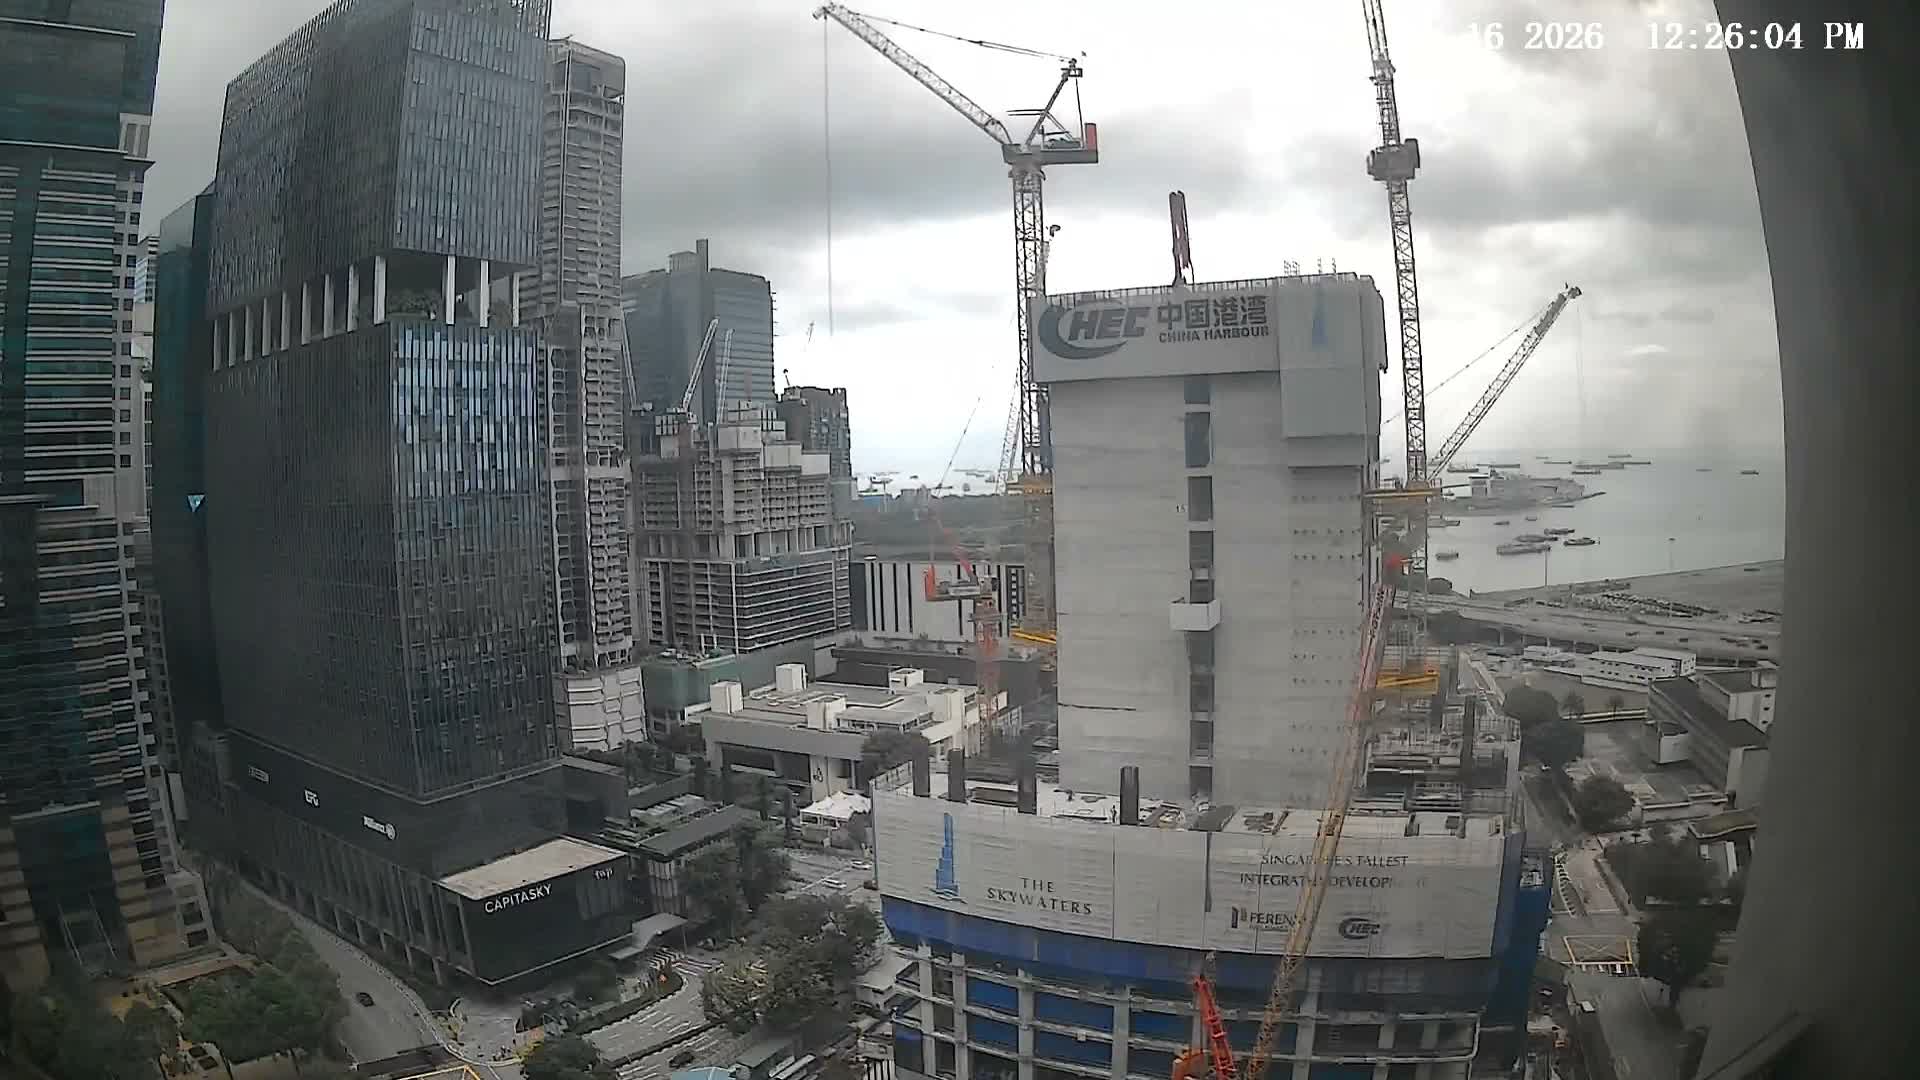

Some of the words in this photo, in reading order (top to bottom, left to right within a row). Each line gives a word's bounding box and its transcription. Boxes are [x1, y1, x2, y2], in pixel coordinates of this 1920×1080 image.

[1157, 295, 1269, 330] 中国港湾
[1159, 330, 1200, 343] CHINA
[1204, 326, 1269, 340] HARBOUR
[1356, 855, 1409, 868] TALLEST
[1020, 877, 1055, 893] THE
[1240, 872, 1322, 887] INTEGRAT
[484, 883, 551, 913] CAPITASKY
[987, 887, 1093, 915] SKYWATERS
